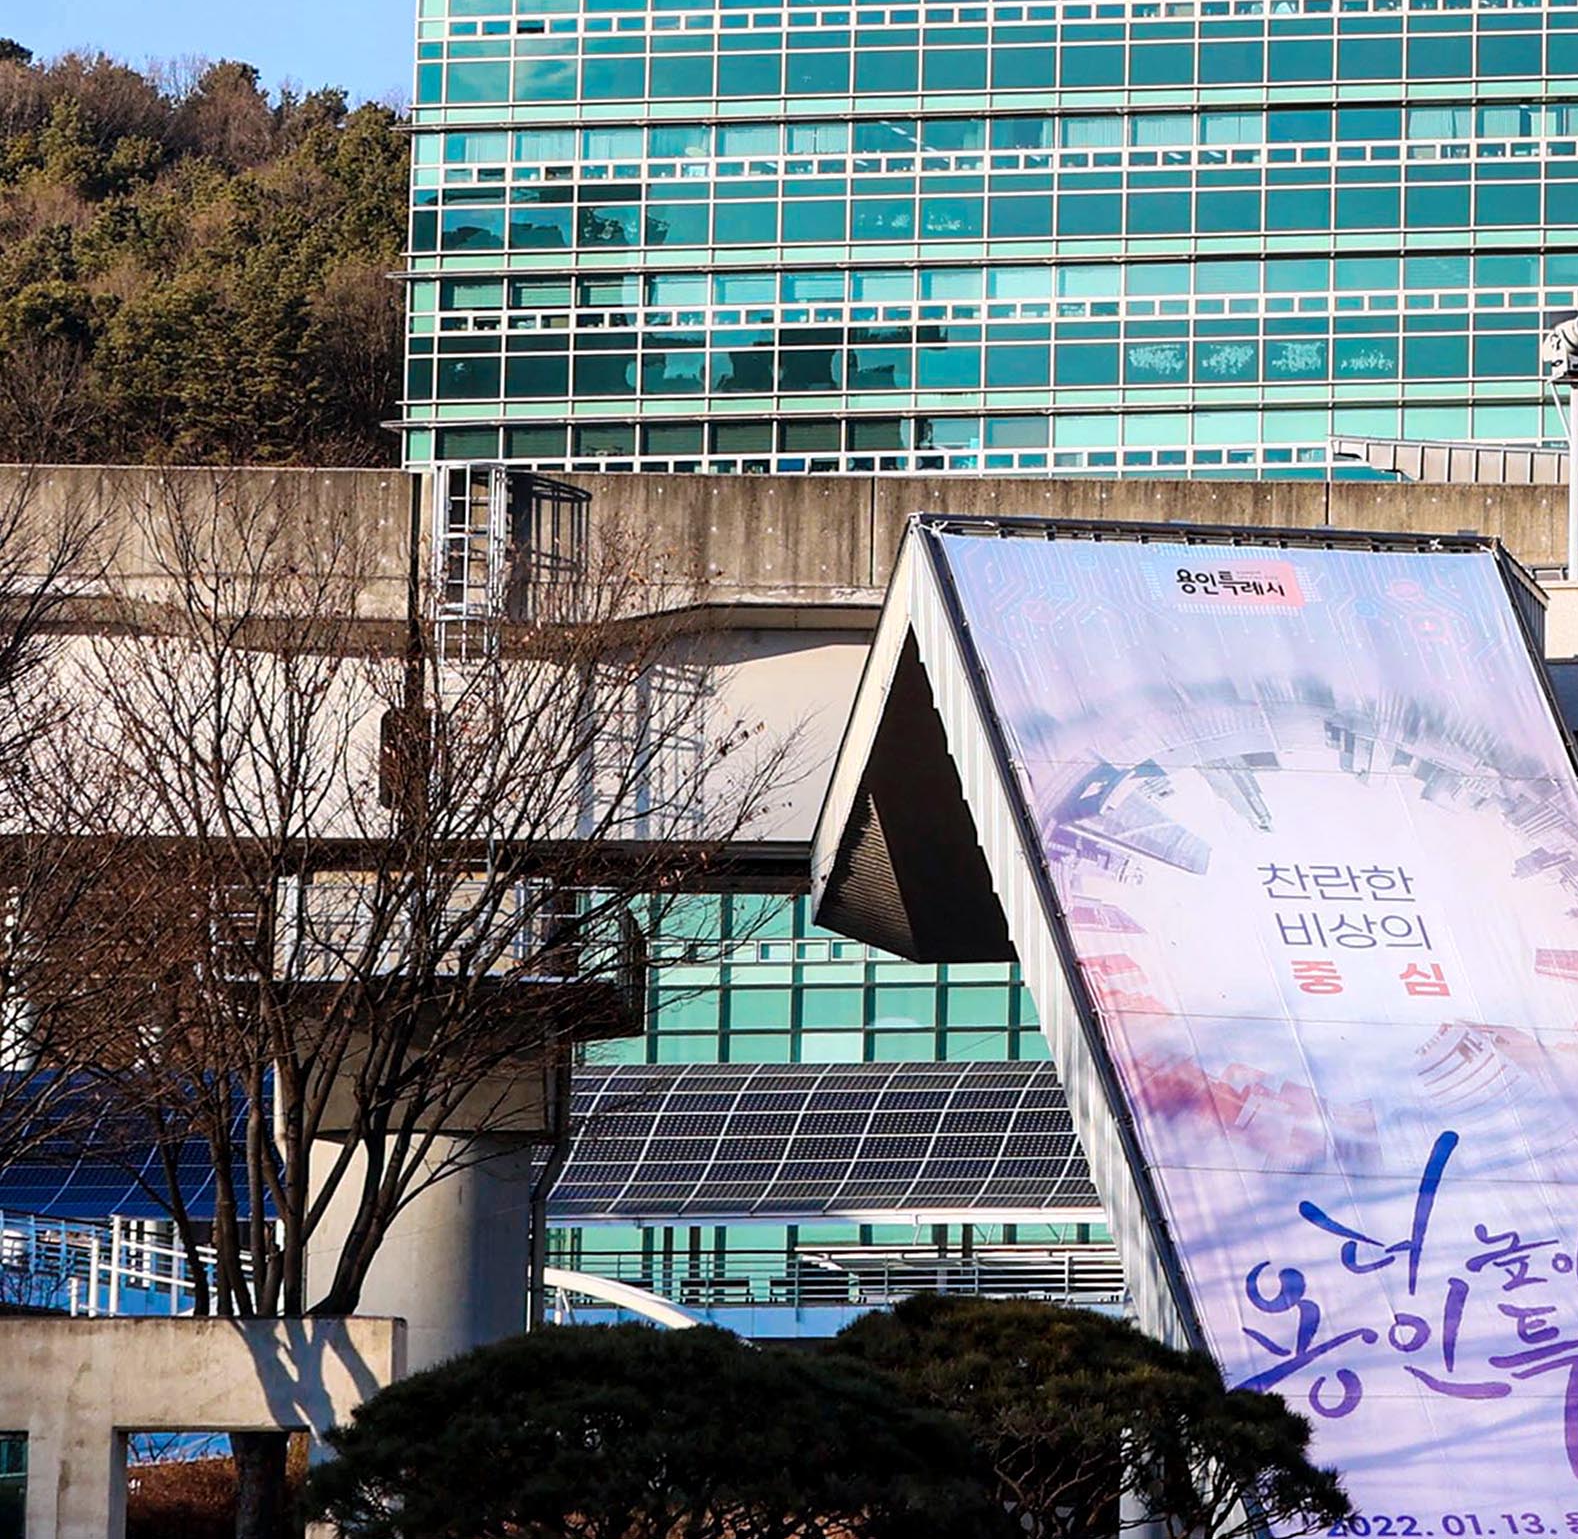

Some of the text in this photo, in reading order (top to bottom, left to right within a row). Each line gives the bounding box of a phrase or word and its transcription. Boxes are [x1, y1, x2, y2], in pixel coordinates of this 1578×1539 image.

[1176, 568, 1286, 596] 용인특례시
[1257, 863, 1416, 902] 찬란한
[1275, 912, 1432, 950] 비상의
[1298, 1130, 1459, 1296] 더
